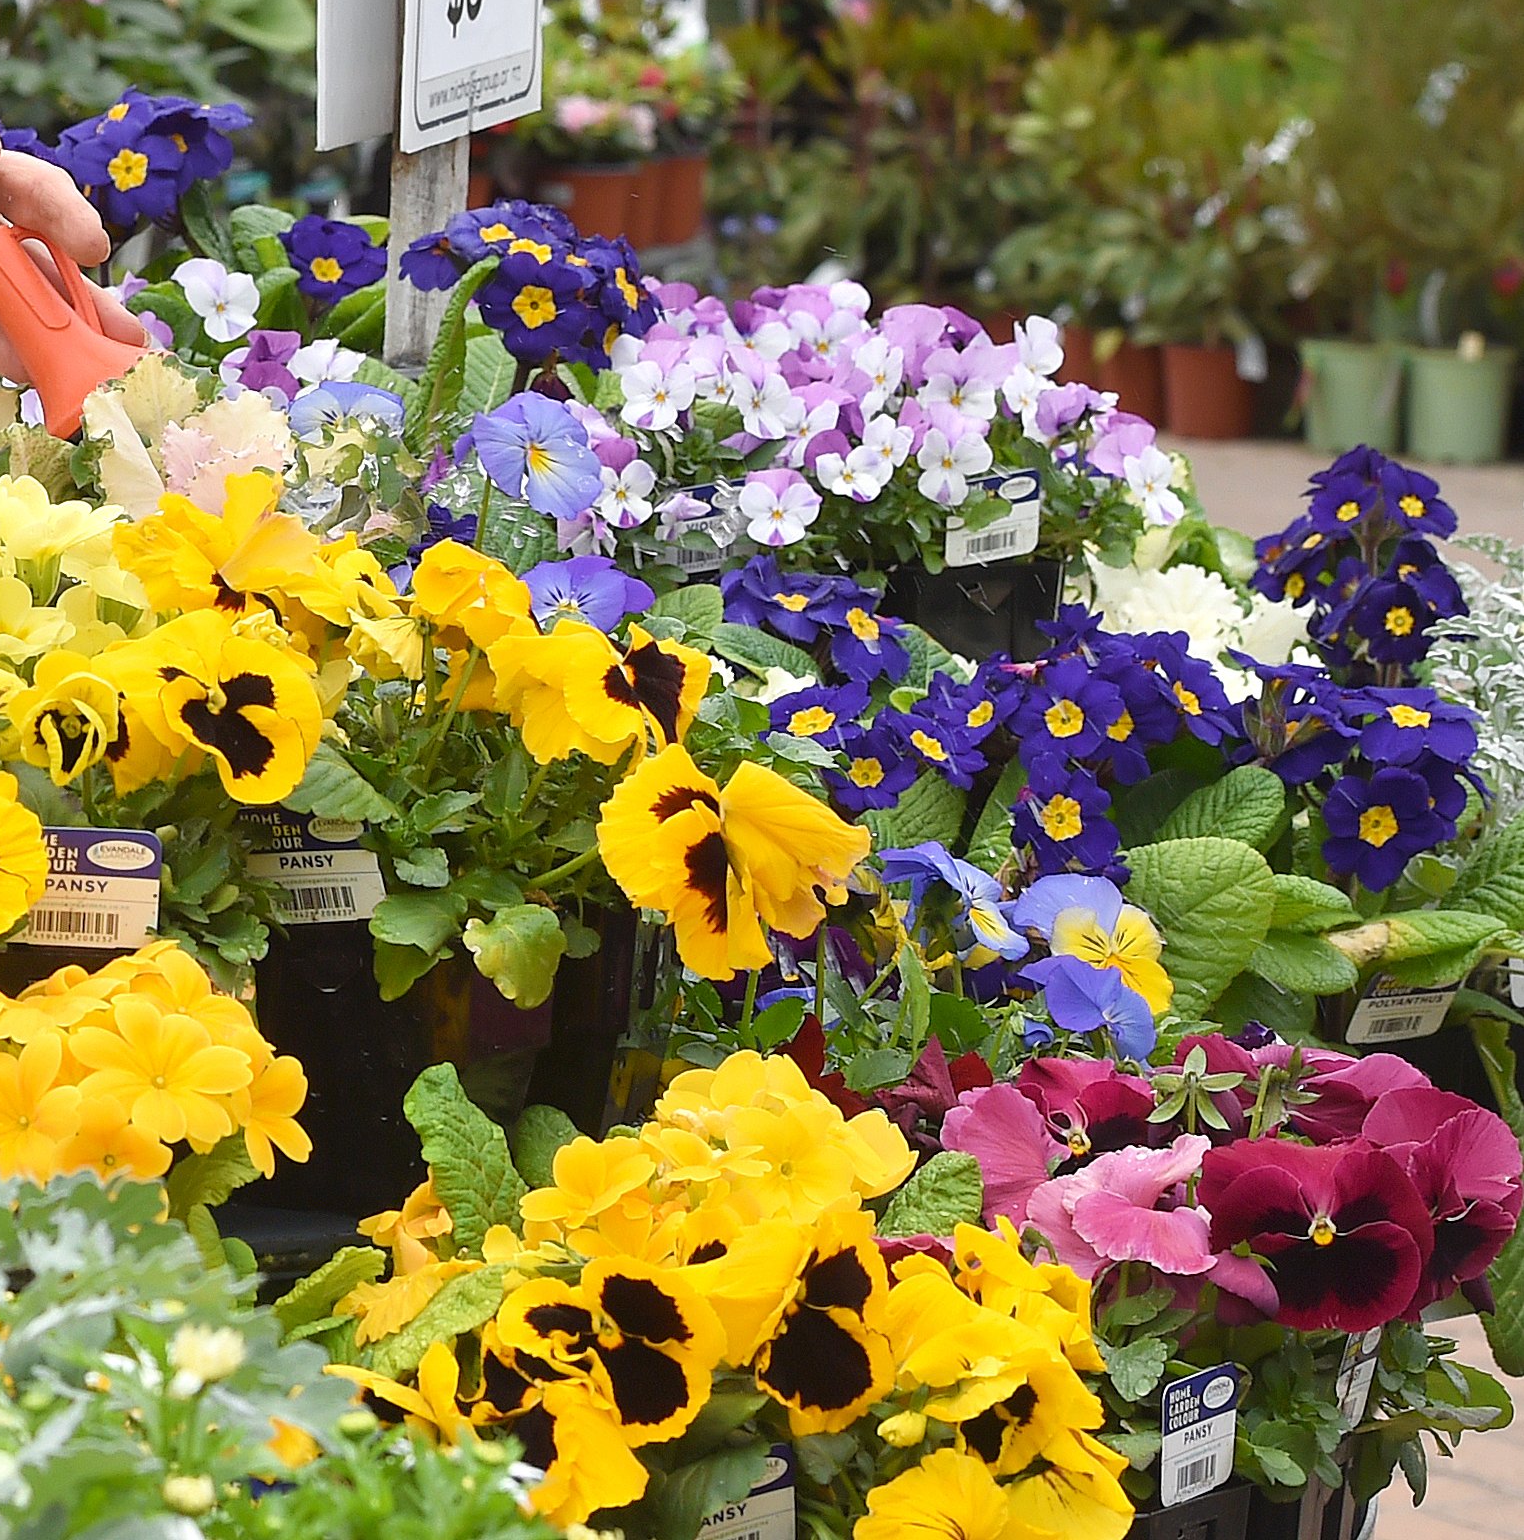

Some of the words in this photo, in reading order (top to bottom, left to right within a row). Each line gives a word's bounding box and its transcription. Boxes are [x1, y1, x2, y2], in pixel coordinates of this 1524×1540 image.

[686, 521, 711, 532] VIO
[100, 845, 146, 855] EVANDALE
[280, 854, 334, 870] PANSY
[45, 878, 109, 894] PANSY
[1368, 994, 1443, 1009] POLYANTHUS
[1169, 1385, 1191, 1404] HOME
[1169, 1395, 1200, 1418] GARDEN
[1169, 1408, 1199, 1431] COLOUR
[1183, 1422, 1213, 1445] PANSY
[701, 1502, 747, 1527] ANSY
